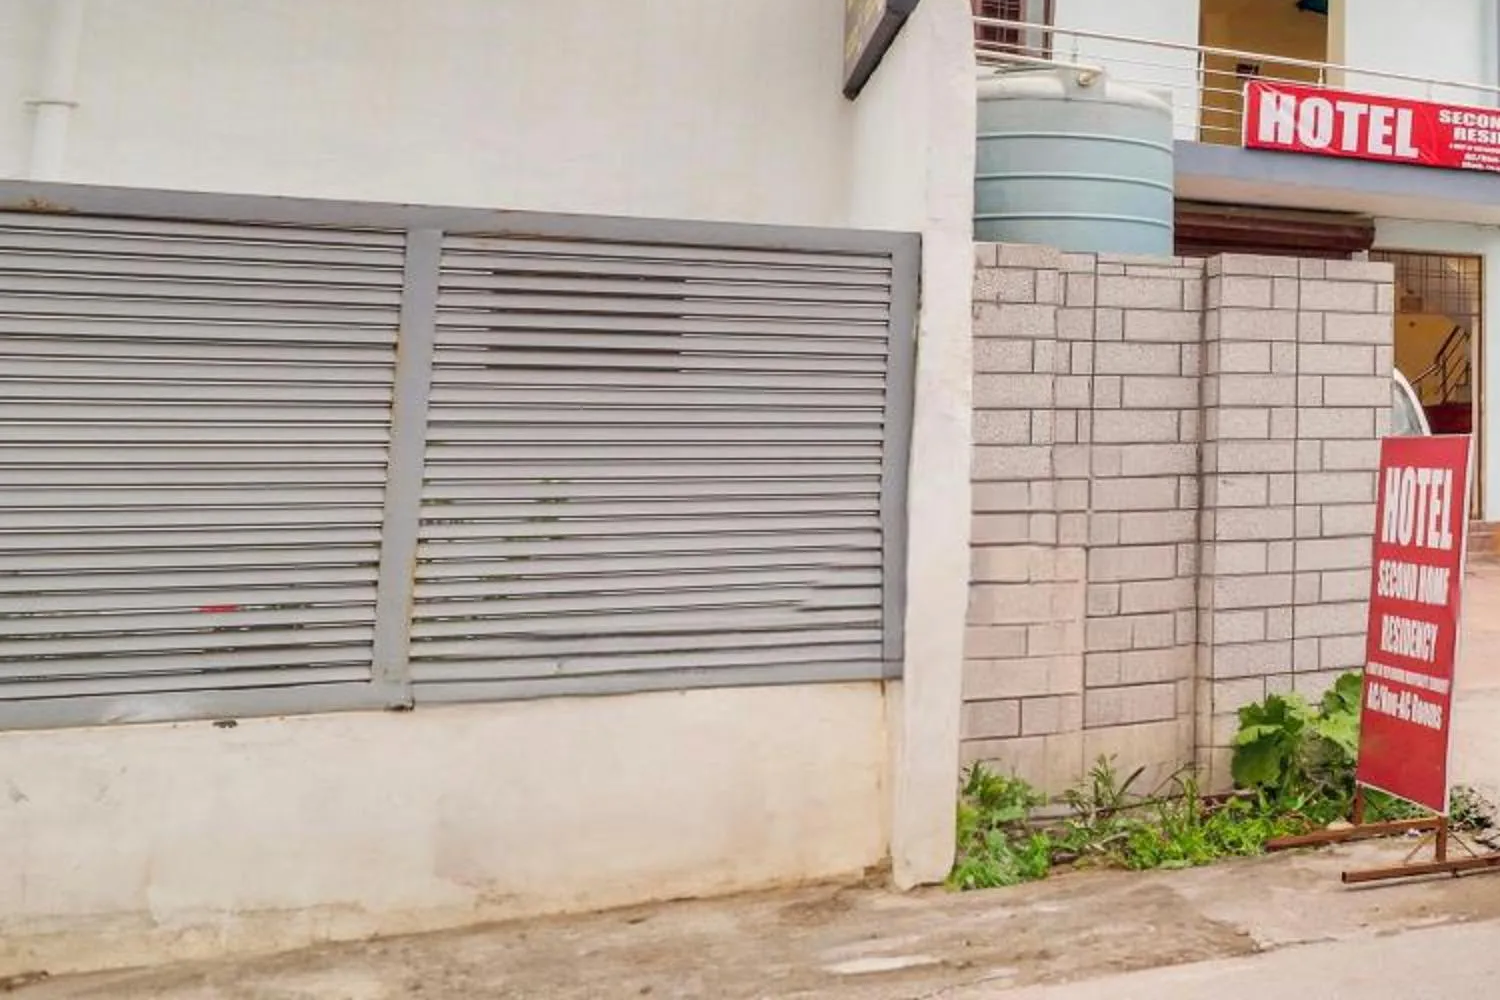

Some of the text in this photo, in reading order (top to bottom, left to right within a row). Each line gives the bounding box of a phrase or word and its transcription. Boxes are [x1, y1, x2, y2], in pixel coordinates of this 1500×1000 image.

[1258, 91, 1419, 159] HOTEL
[1381, 466, 1453, 550] HOTEL
[1377, 558, 1450, 606] SECOND HOME
[1381, 615, 1439, 663] RESIDENCY
